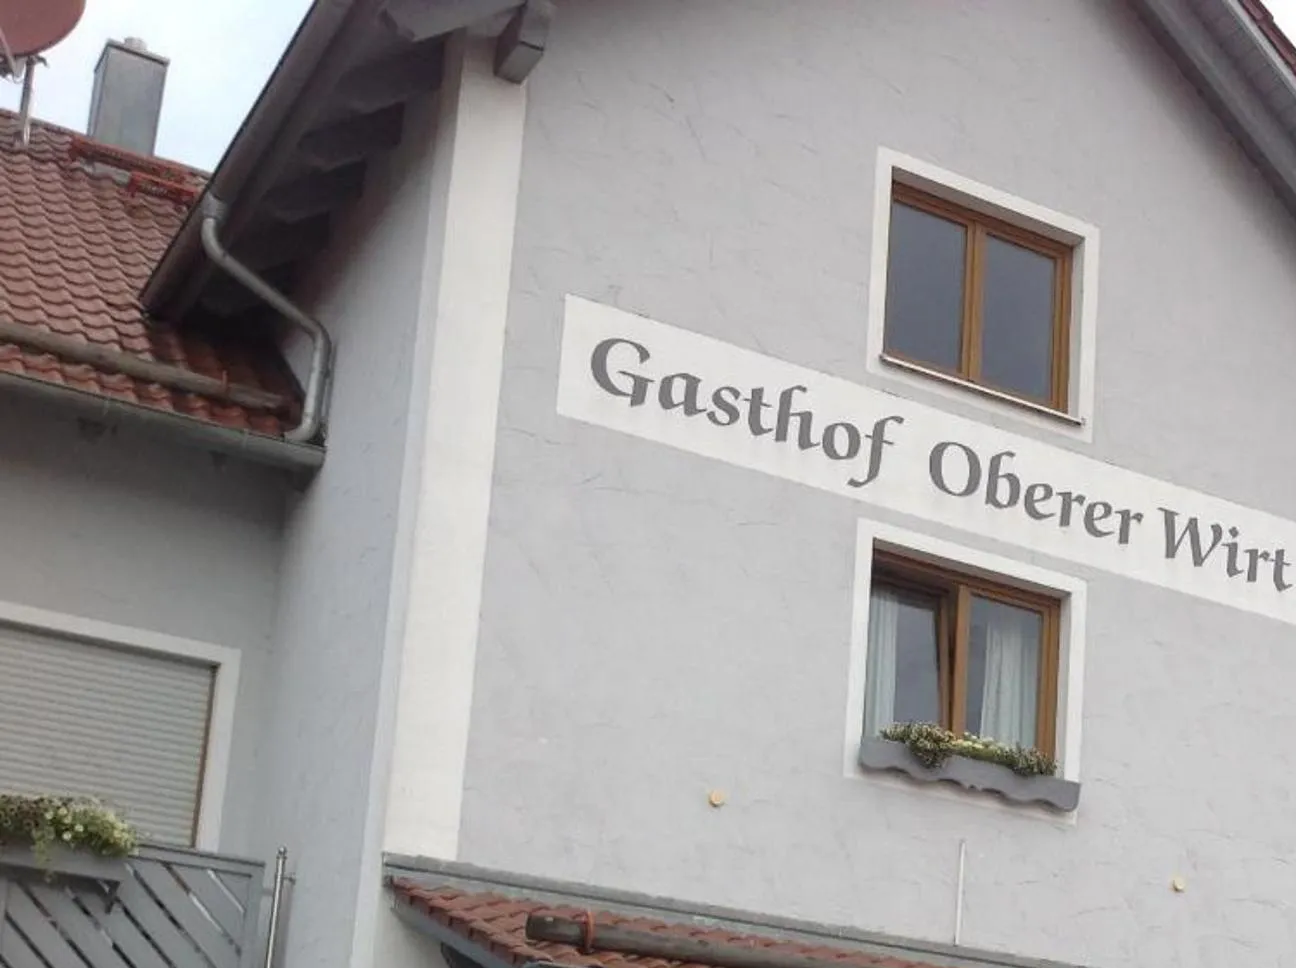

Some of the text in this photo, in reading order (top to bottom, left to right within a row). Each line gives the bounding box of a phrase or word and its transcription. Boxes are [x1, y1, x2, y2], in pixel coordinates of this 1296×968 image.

[590, 337, 1294, 592] Gasthof Oberer Wirt
